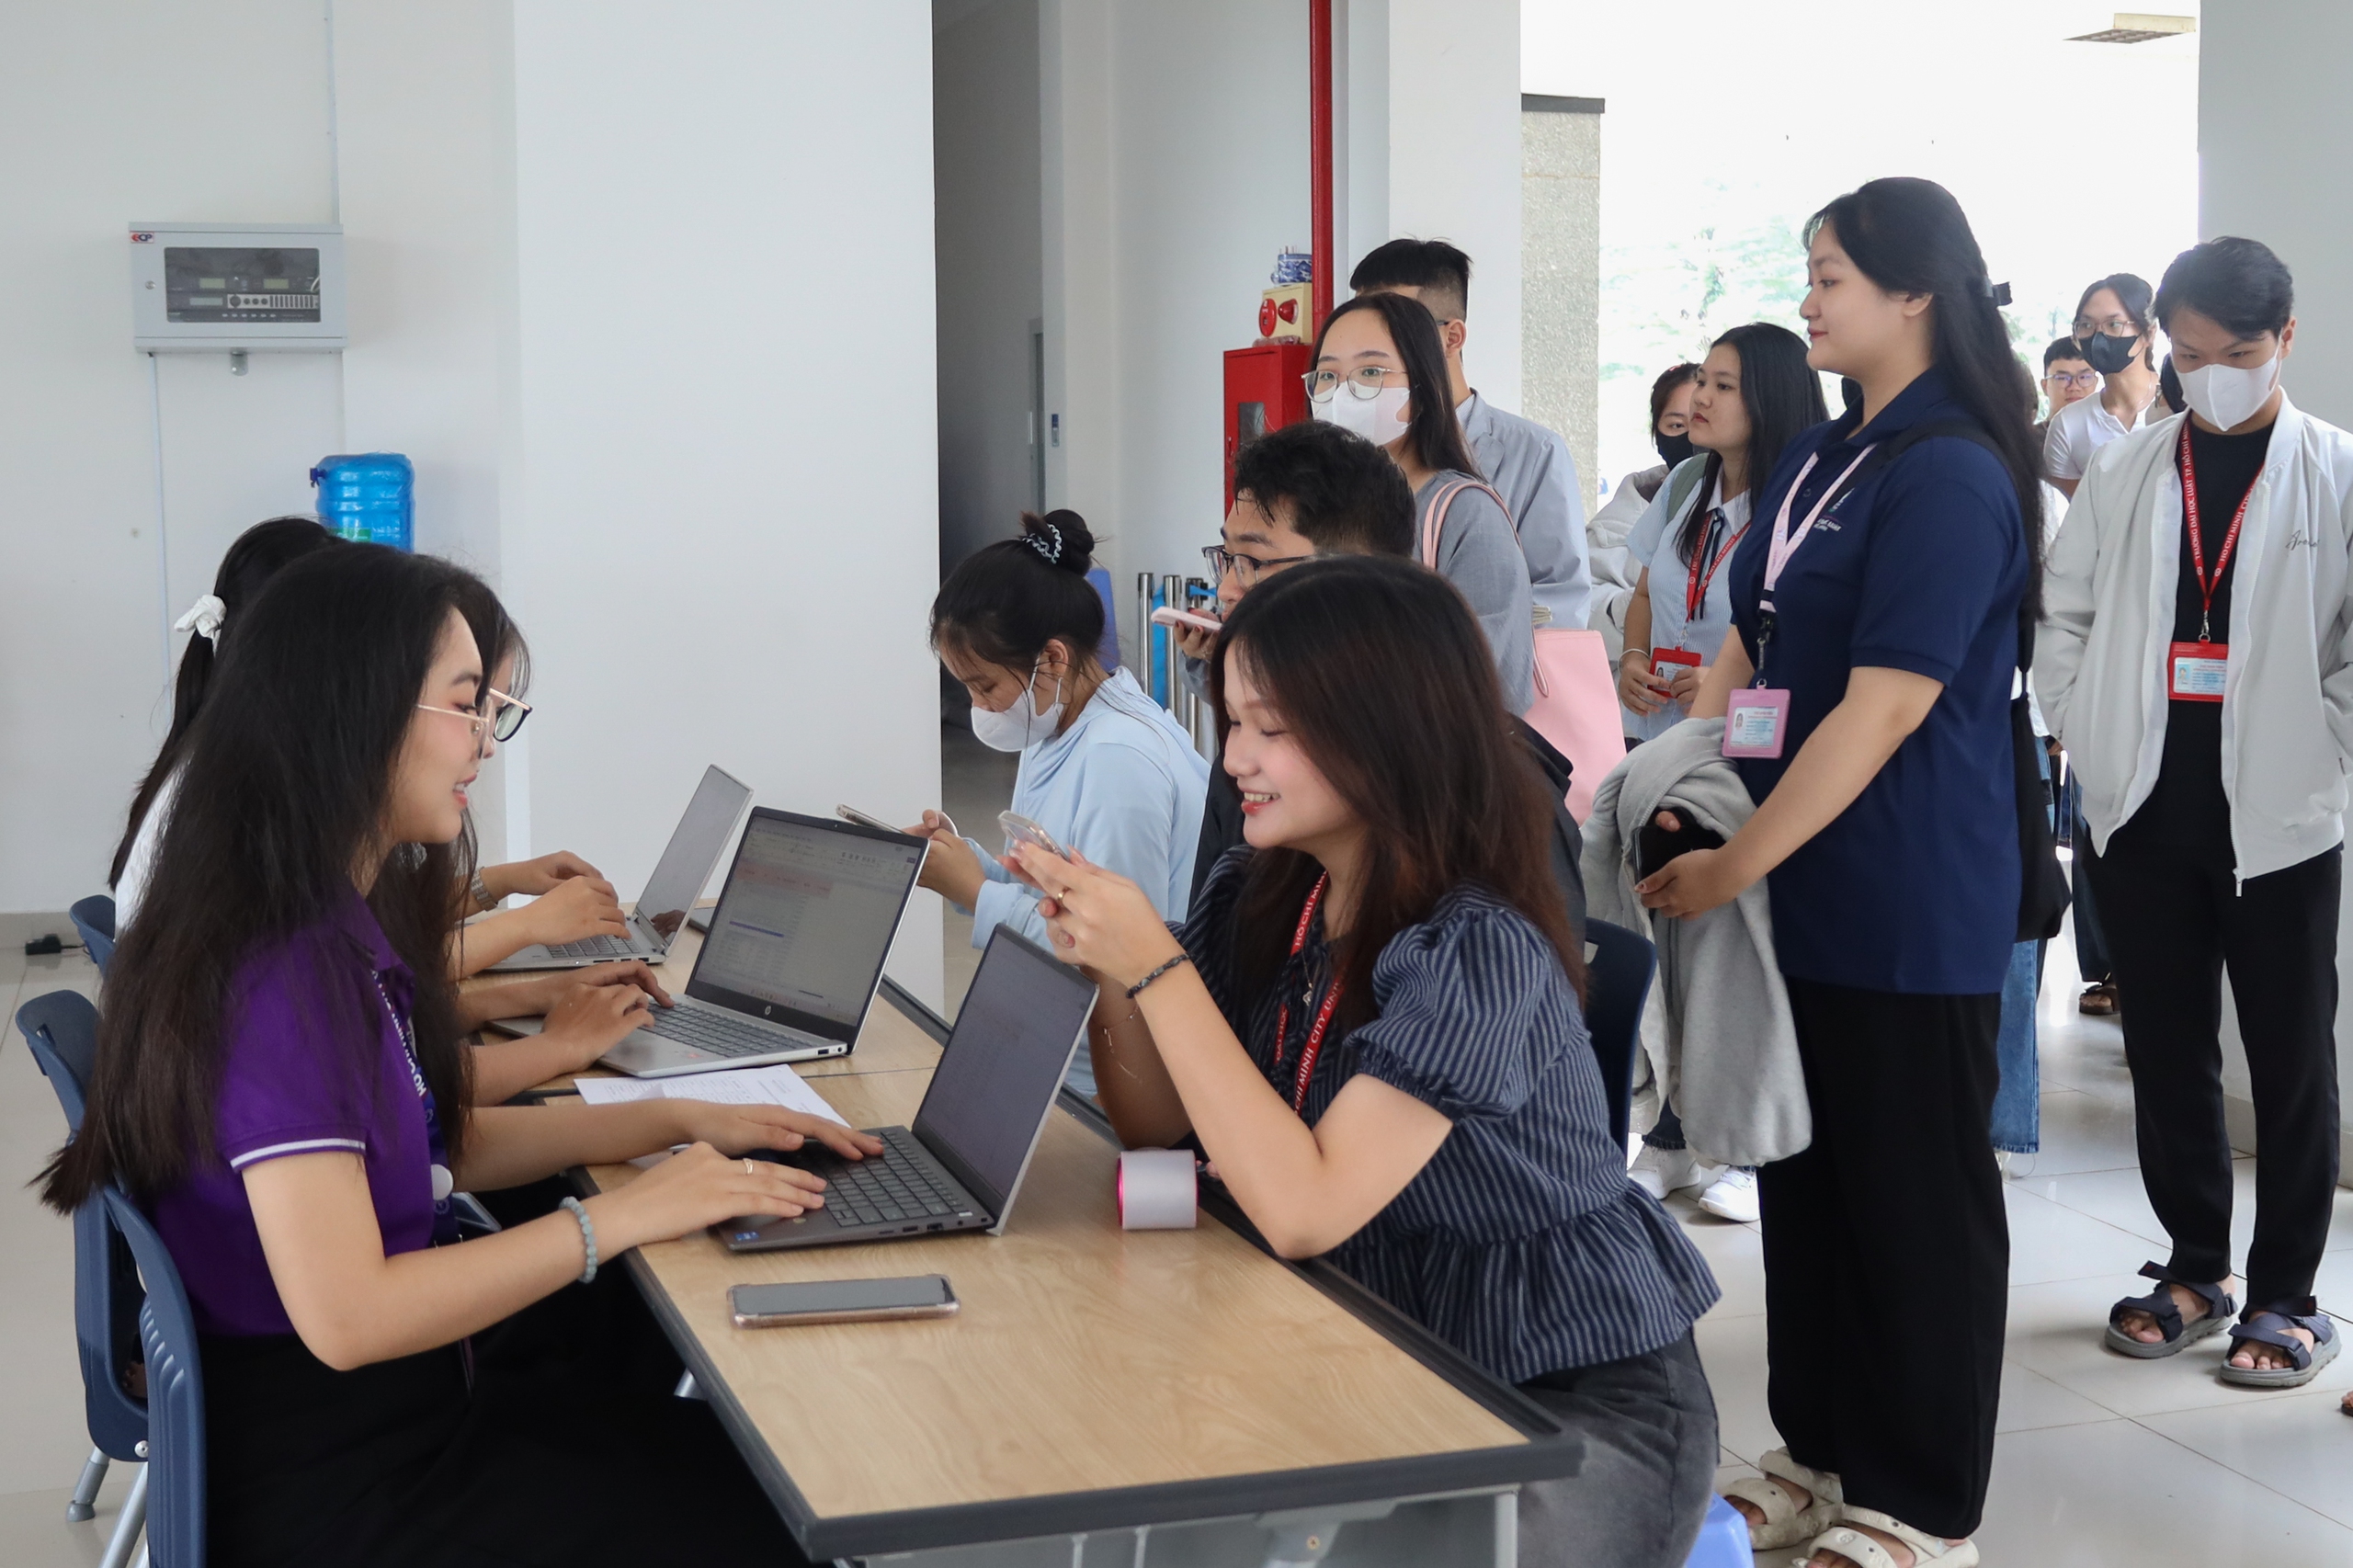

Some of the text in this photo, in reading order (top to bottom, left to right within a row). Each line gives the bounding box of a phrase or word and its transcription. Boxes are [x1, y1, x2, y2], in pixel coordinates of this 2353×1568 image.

[2230, 511, 2244, 533] MINH
[1299, 1047, 1314, 1085] MINH
[1311, 1013, 1326, 1043] CITY
